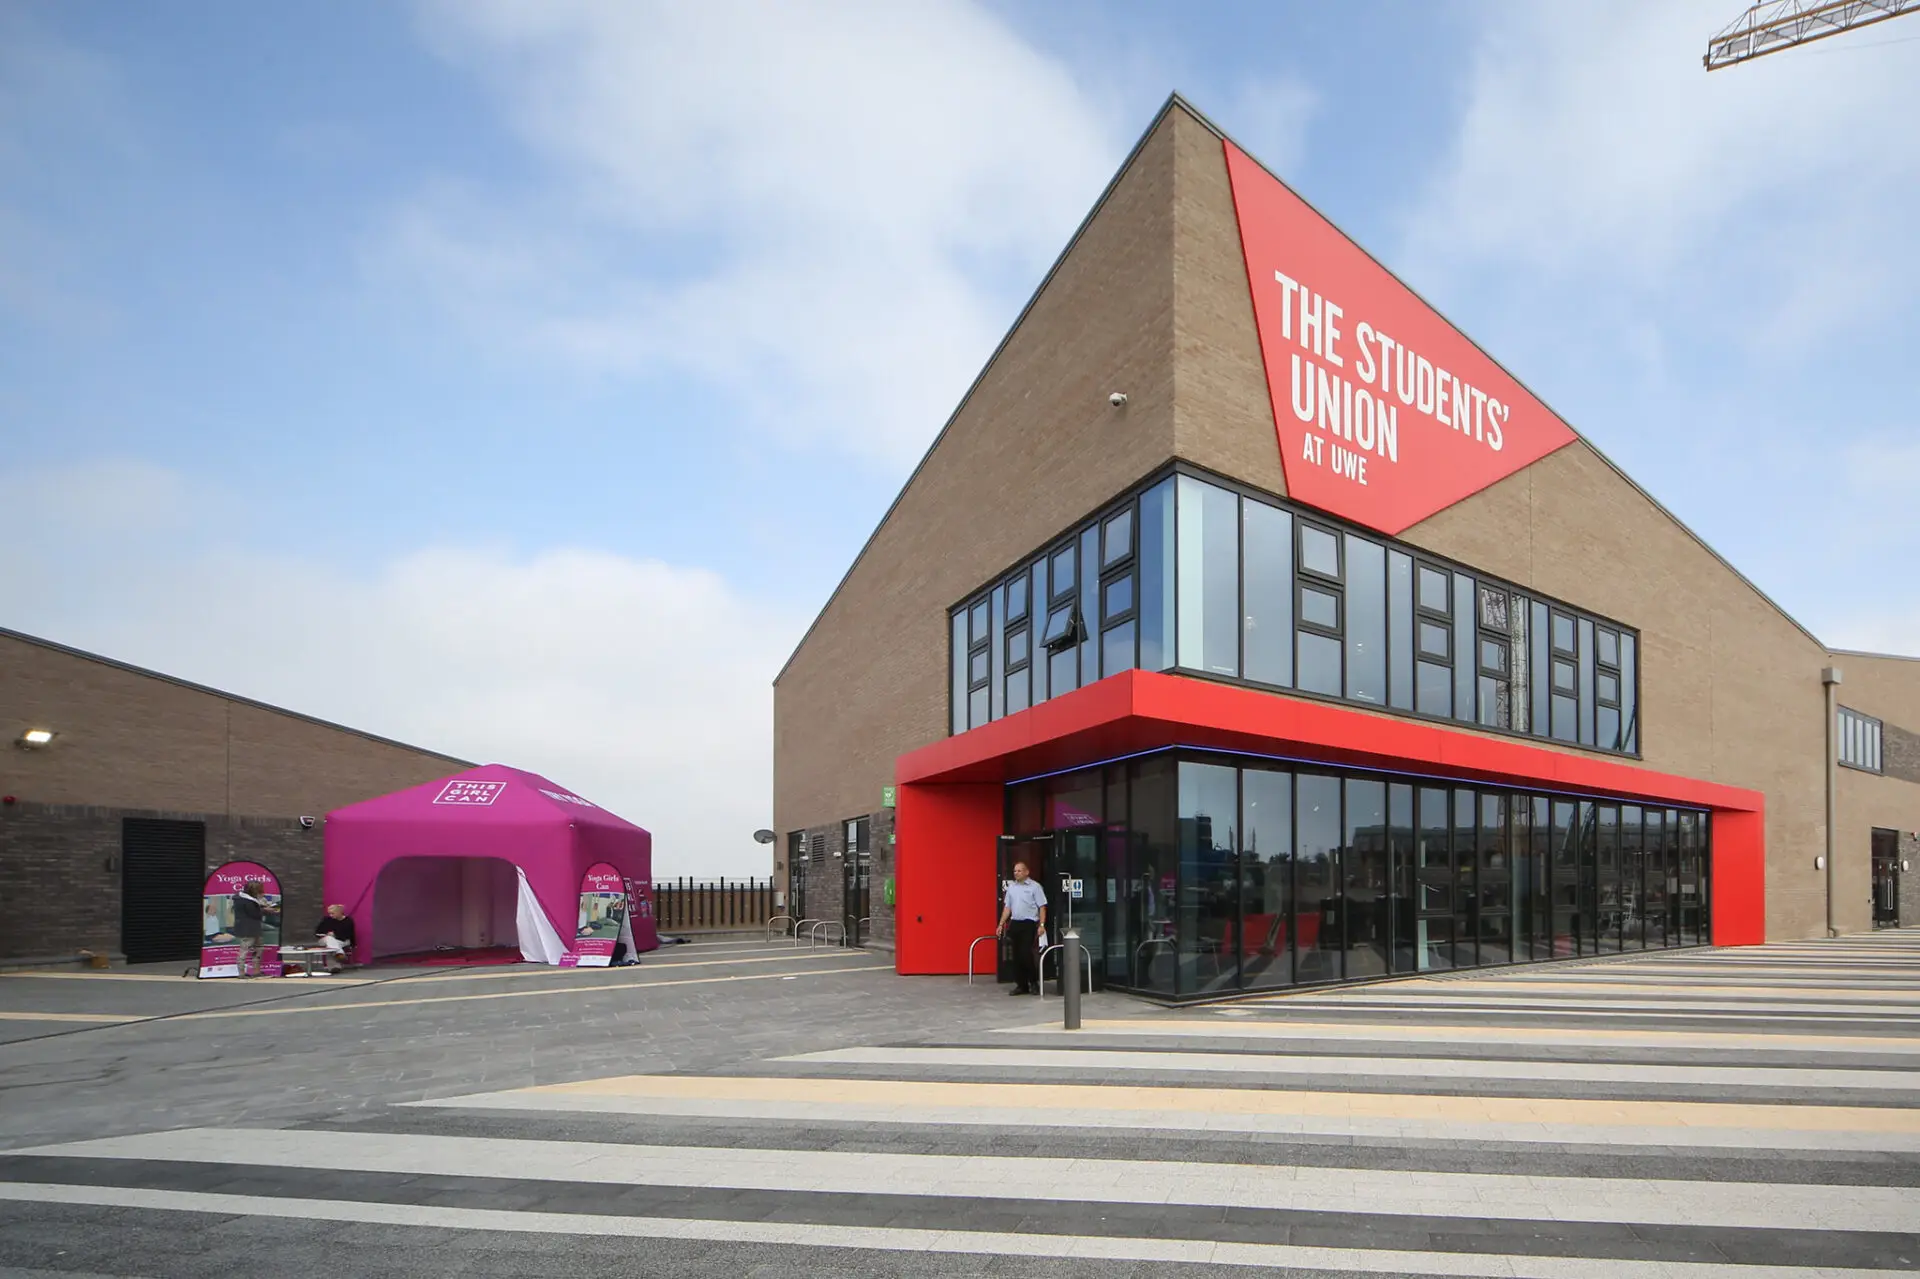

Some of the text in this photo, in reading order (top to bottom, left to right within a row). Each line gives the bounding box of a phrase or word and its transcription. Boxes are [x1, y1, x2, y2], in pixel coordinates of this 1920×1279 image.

[1275, 269, 1343, 367] THE
[1291, 353, 1397, 463] UNION
[1302, 432, 1367, 485] AT UWE
[216, 873, 272, 884] Yoga Girls
[588, 875, 602, 883] Yoga
